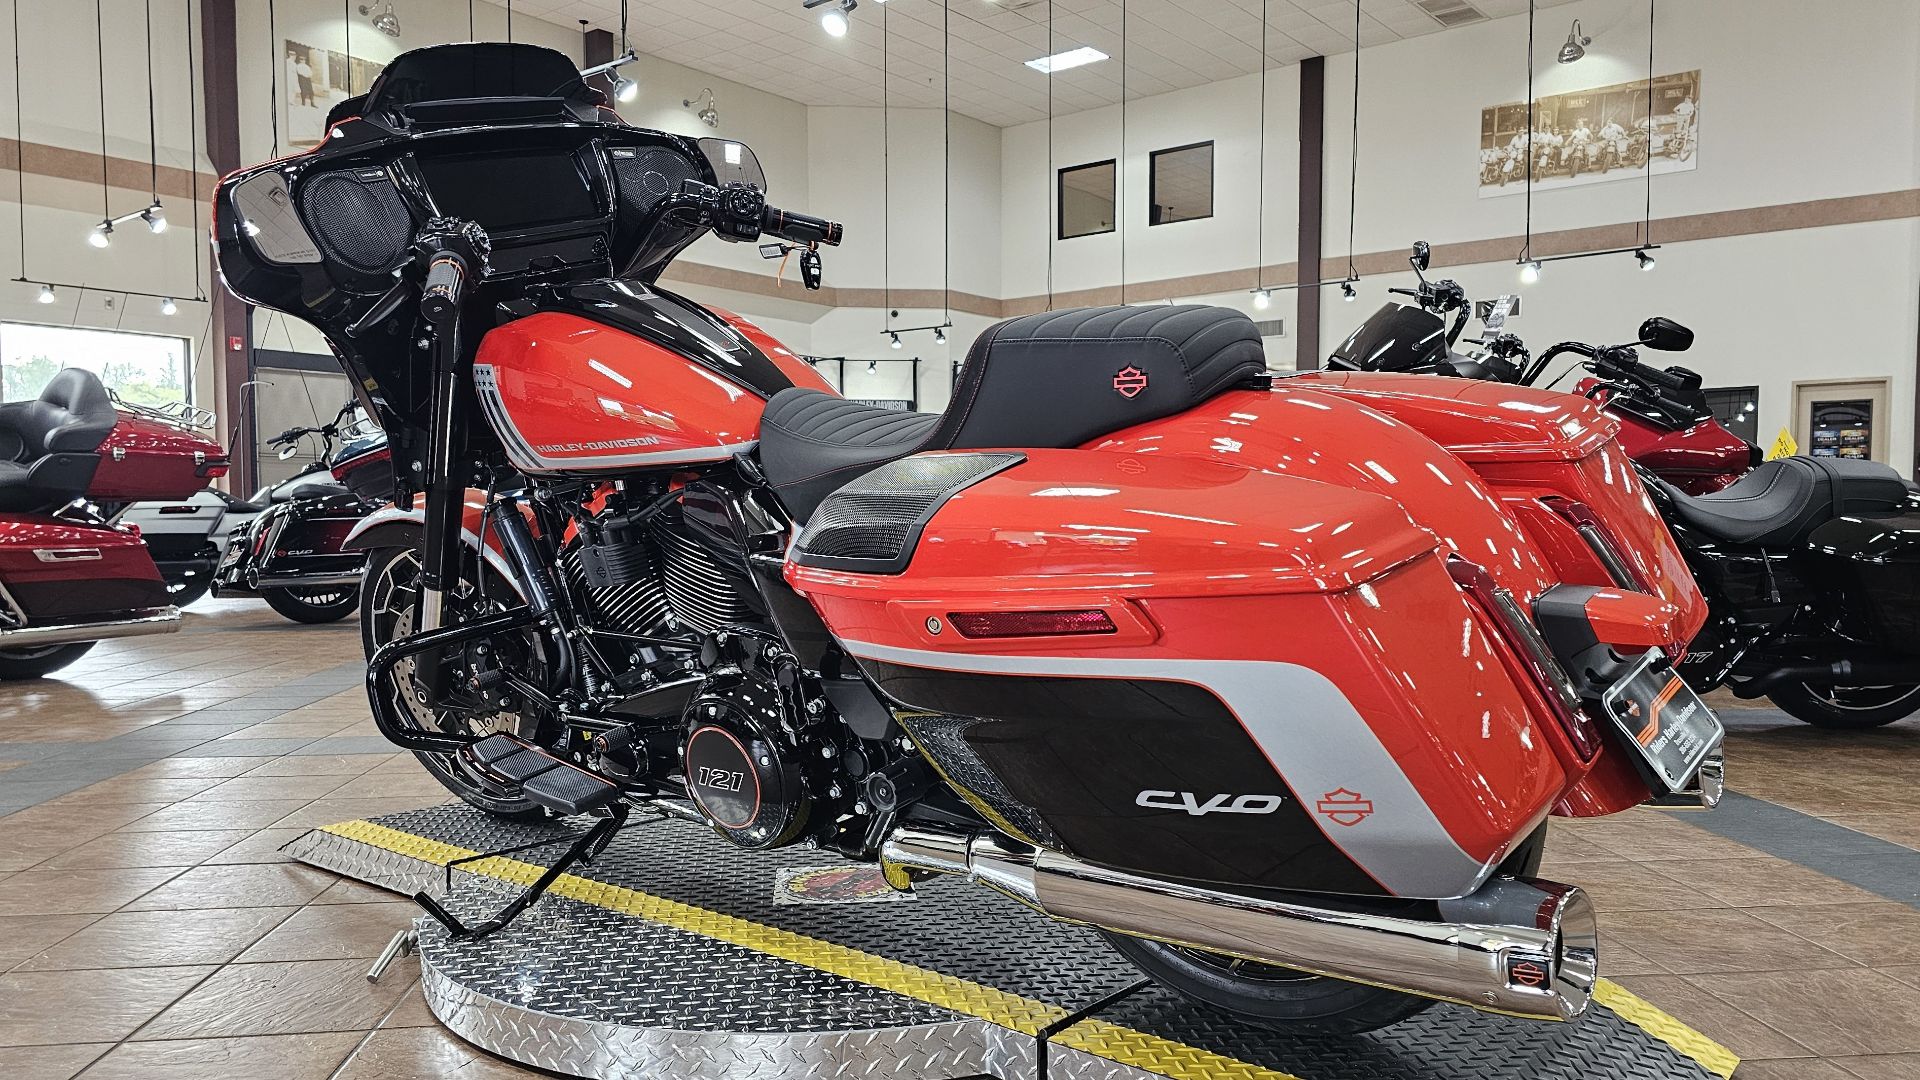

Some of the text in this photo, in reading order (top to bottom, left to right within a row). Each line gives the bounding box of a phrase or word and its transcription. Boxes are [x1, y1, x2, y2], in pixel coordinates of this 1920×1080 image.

[537, 434, 660, 453] HARLEY-DAVIDSON
[1683, 651, 1714, 664] 17
[1650, 735, 1669, 755] Riders
[1662, 722, 1682, 740] Harley
[698, 766, 745, 793] 121
[1135, 789, 1282, 816] CVO
